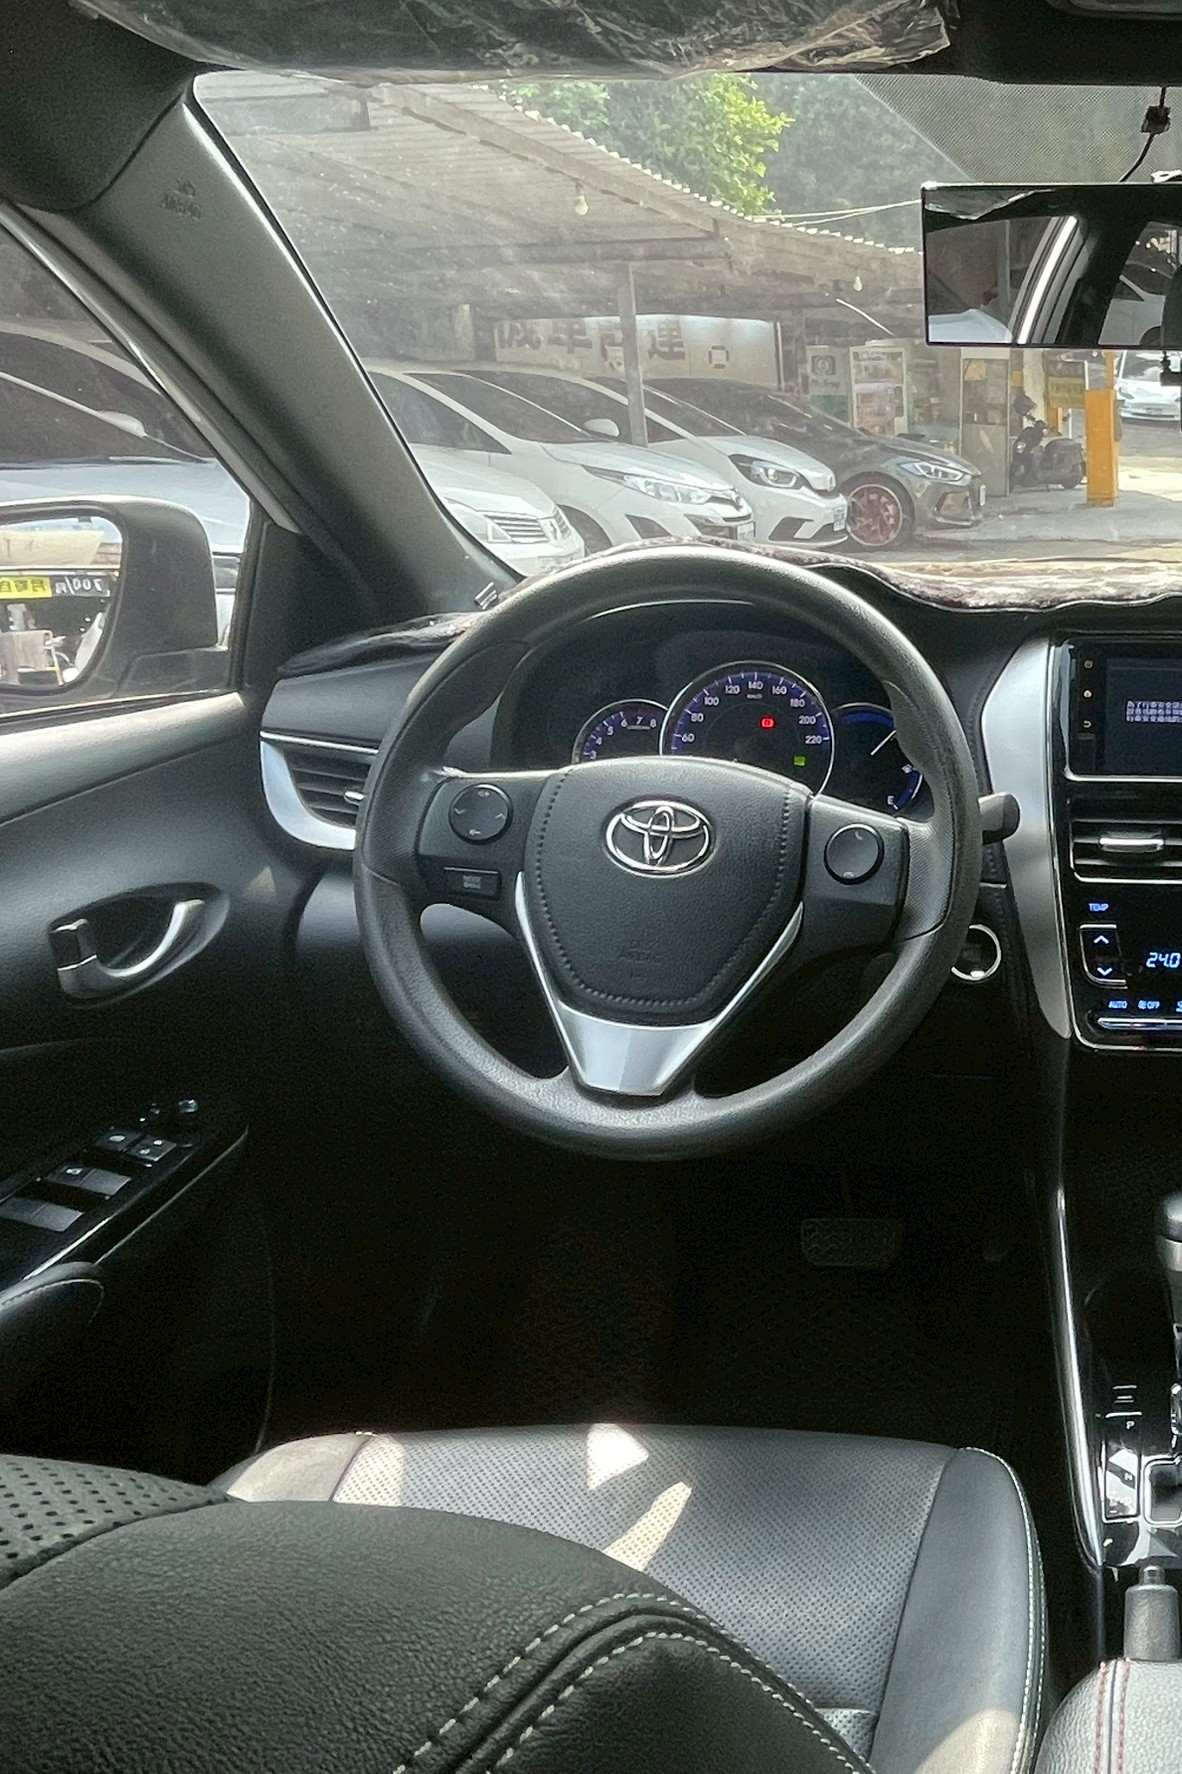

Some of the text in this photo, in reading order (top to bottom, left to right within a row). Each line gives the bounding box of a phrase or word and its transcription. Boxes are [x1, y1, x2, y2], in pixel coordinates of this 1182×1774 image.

[725, 685, 740, 694] 120
[748, 681, 764, 690] 140
[772, 686, 788, 695] 160
[704, 696, 719, 706] 100
[790, 698, 805, 708] 180
[636, 716, 643, 725] 7
[691, 713, 704, 722] 80
[798, 714, 817, 724] 200
[620, 719, 628, 727] 6
[649, 718, 657, 728] 8
[607, 726, 614, 736] 5
[681, 733, 695, 742] 60
[804, 735, 822, 744] 220
[887, 795, 895, 805] E
[1088, 903, 1109, 912] TEMP
[1108, 1000, 1128, 1009] AUTO
[1147, 1001, 1160, 1009] OFF
